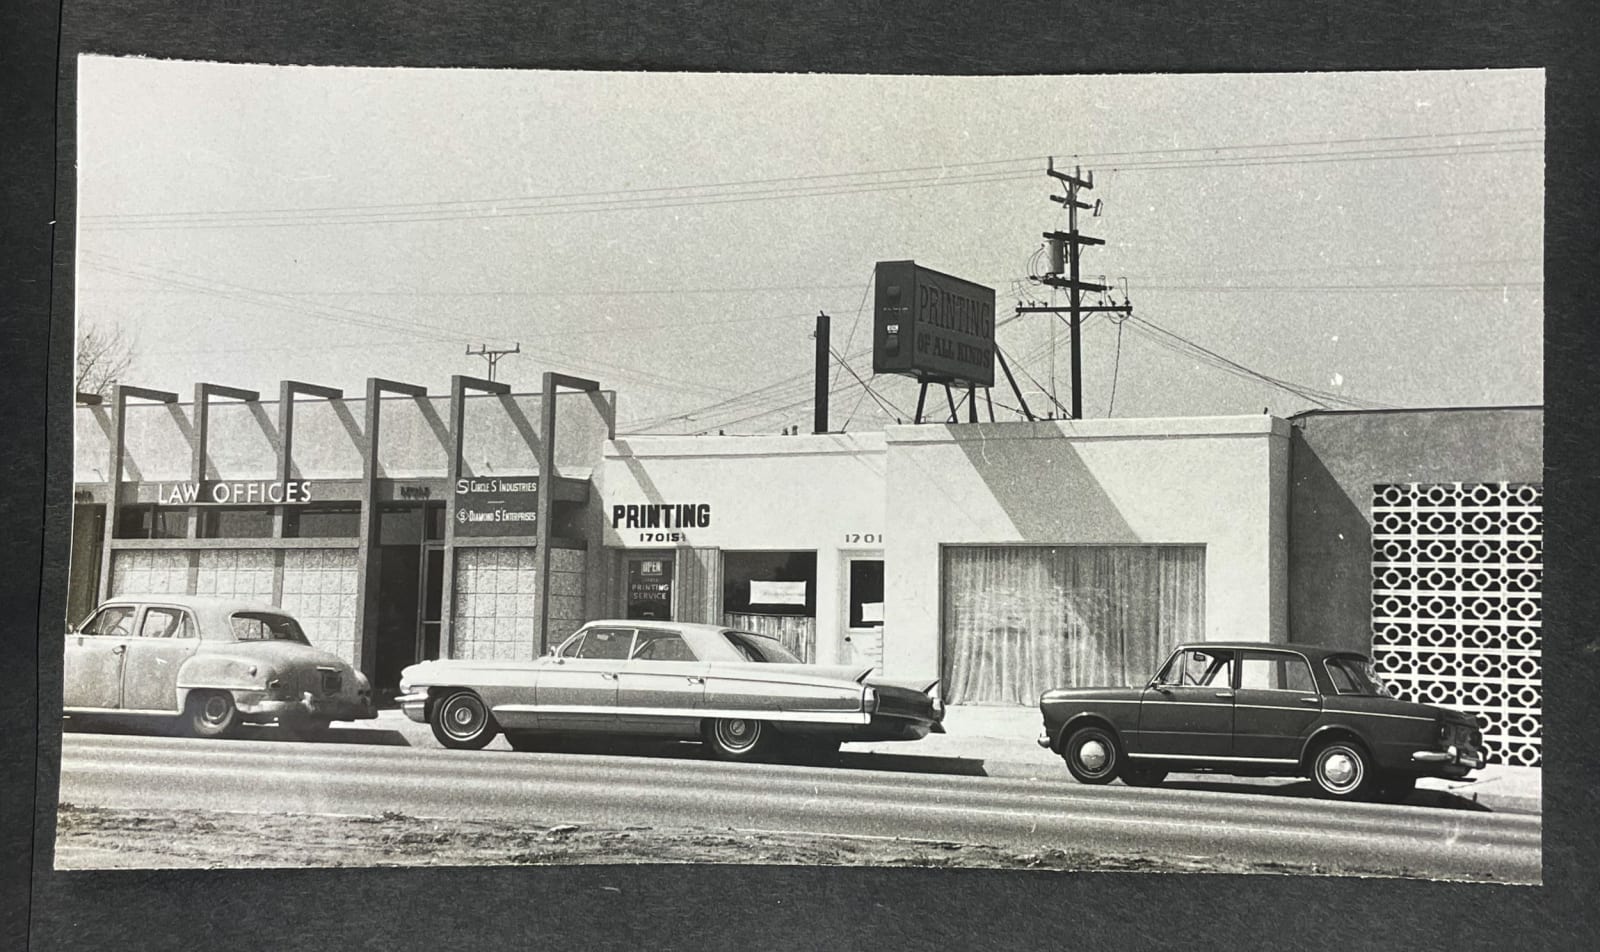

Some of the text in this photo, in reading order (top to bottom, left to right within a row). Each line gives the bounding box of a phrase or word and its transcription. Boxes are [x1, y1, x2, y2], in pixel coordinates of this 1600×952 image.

[918, 284, 990, 338] PRINTING
[917, 332, 931, 354] OF
[932, 335, 954, 361] ALL
[158, 481, 312, 505] LAW OFFICES
[491, 480, 497, 493] S
[495, 510, 501, 522] S
[612, 504, 710, 528] PRINTING
[642, 562, 661, 573] OPEN
[633, 592, 667, 600] SERVICE
